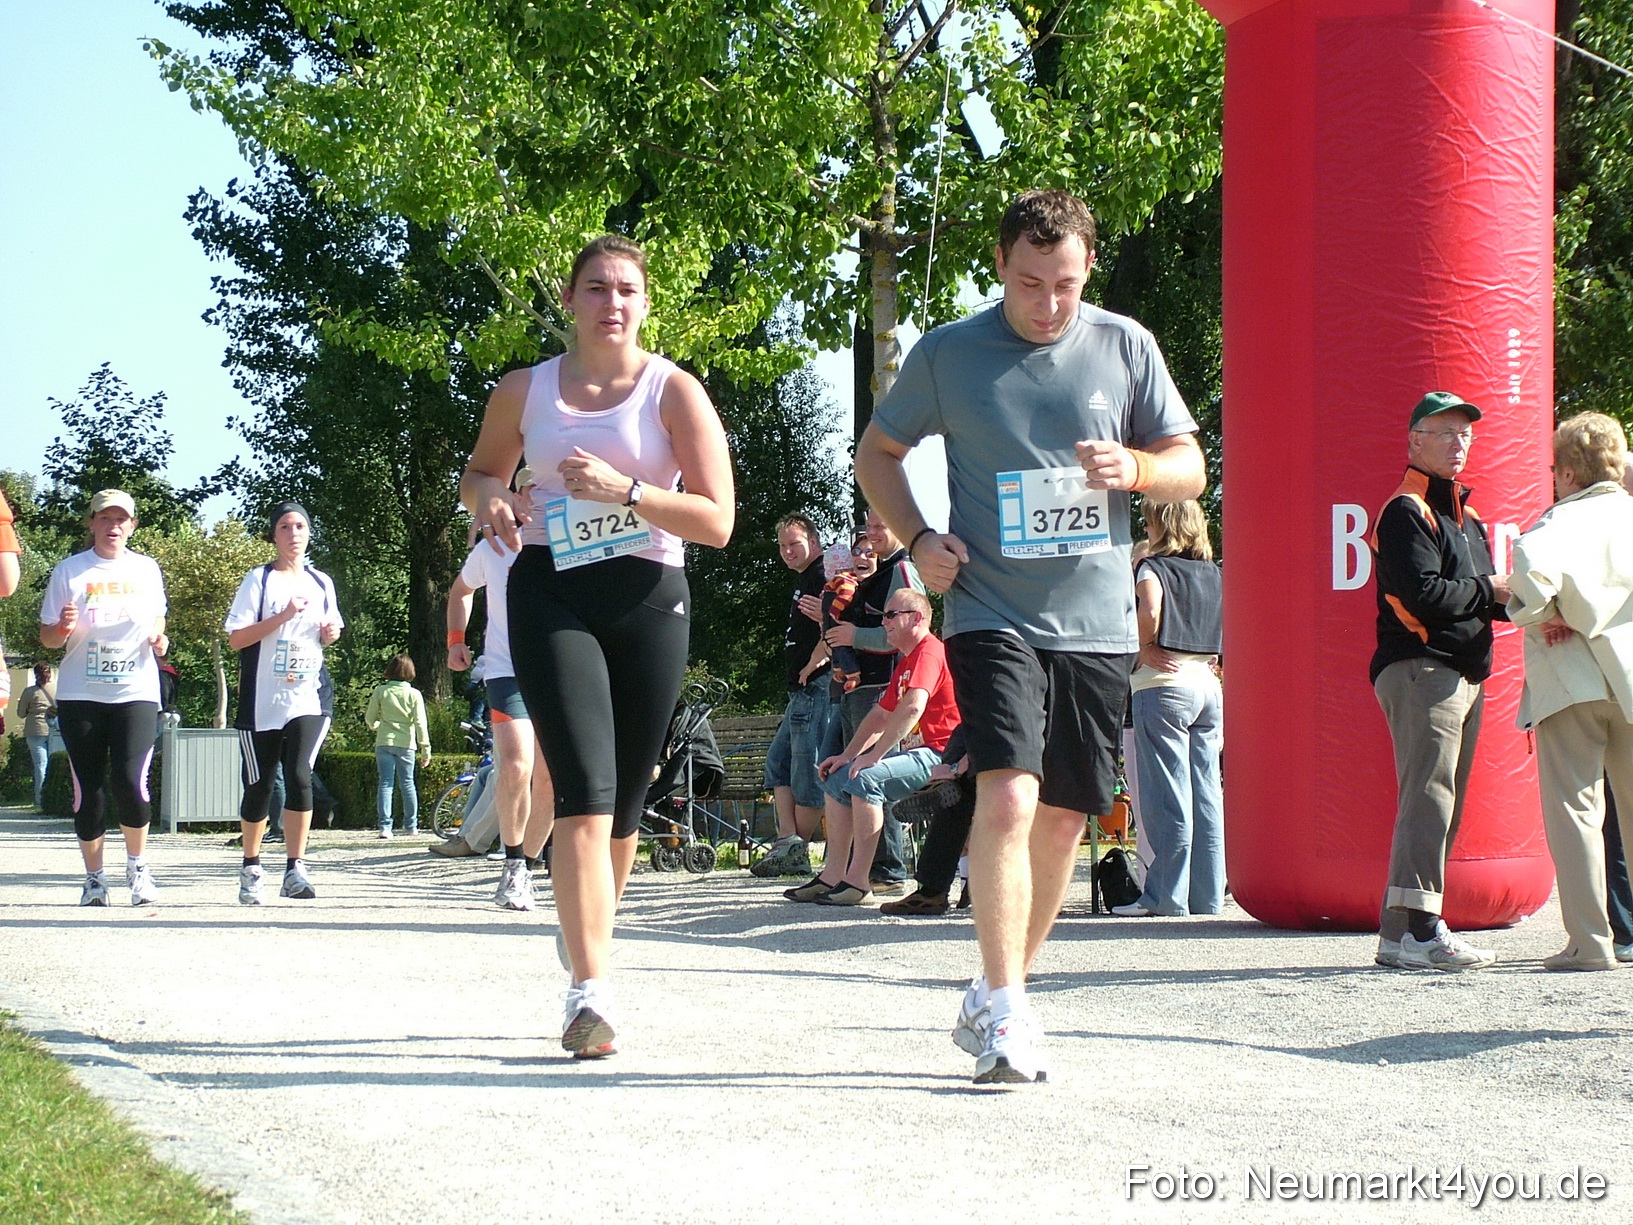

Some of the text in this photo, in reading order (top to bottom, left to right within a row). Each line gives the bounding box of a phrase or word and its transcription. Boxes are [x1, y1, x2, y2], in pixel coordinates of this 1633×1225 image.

[1508, 327, 1521, 404] Seit 1929
[575, 509, 640, 541] 3724
[1033, 506, 1100, 533] 3725
[1069, 540, 1109, 550] PFLEIDERER
[101, 660, 136, 673] 2672
